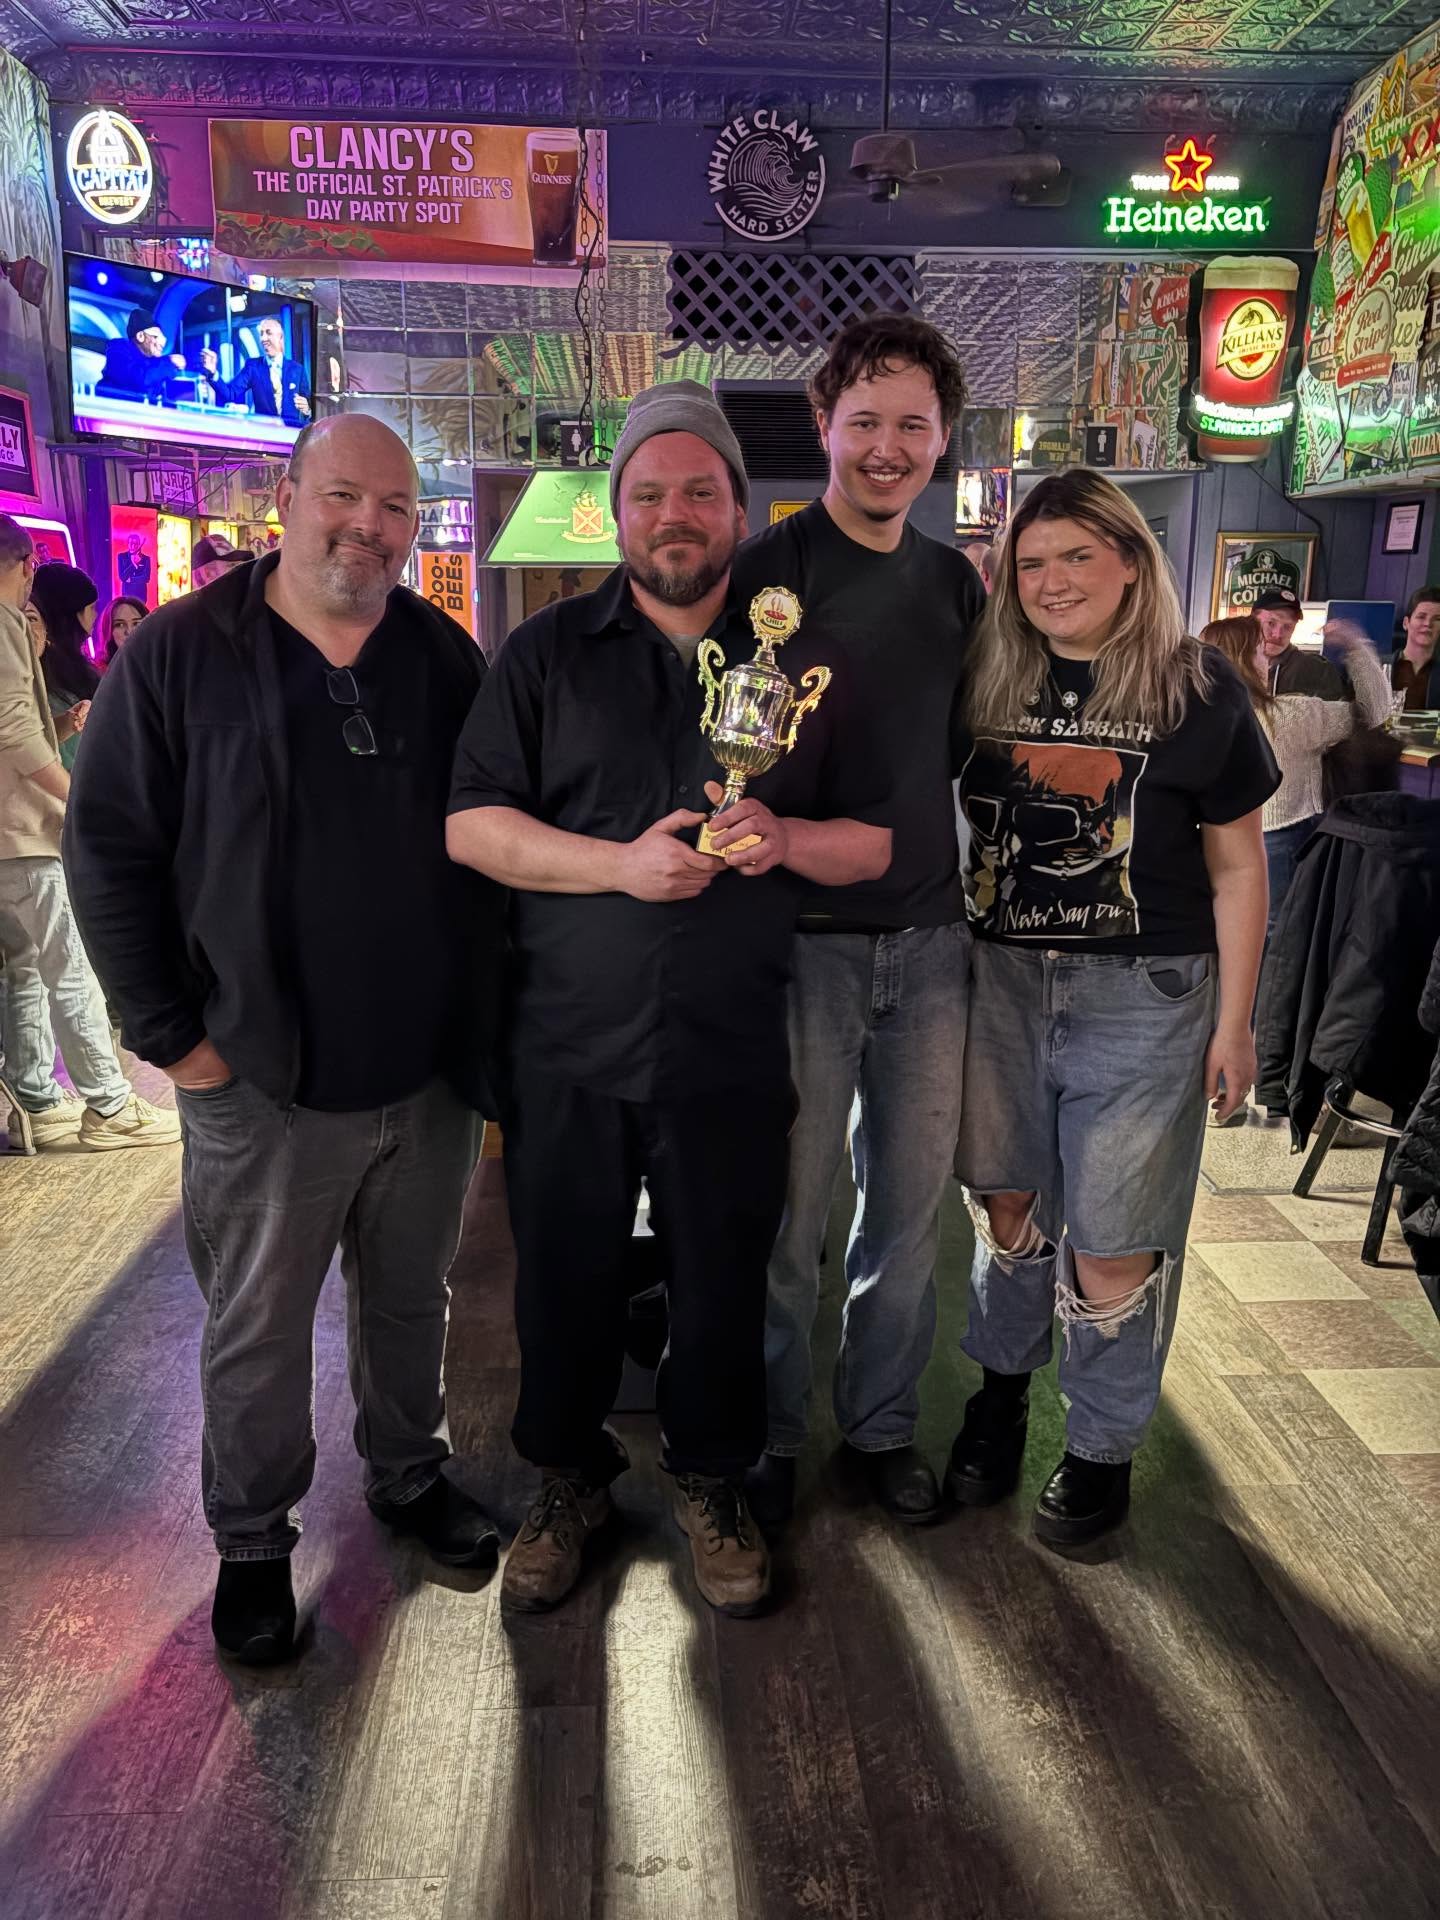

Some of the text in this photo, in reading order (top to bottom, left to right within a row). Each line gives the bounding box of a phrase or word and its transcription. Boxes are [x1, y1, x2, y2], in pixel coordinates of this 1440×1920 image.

[289, 125, 475, 173] CLANCY'S
[708, 109, 819, 194] WHITE CLAW
[253, 171, 514, 199] THE OFFICIAL ST. PATRICK'S
[531, 172, 572, 185] GUINNESS
[306, 199, 463, 224] DAY PARTY SPOT
[727, 170, 820, 234] HARD SELTZER
[1106, 196, 1266, 233] Heineken
[1355, 301, 1384, 337] Red
[1350, 324, 1388, 360] Stripe
[446, 555, 464, 611] BEES
[1237, 572, 1293, 588] MICHAEL
[765, 616, 783, 626] CHILI
[1050, 717, 1154, 743] SABBATH
[1003, 899, 1054, 931] Never
[1053, 899, 1091, 929] Say
